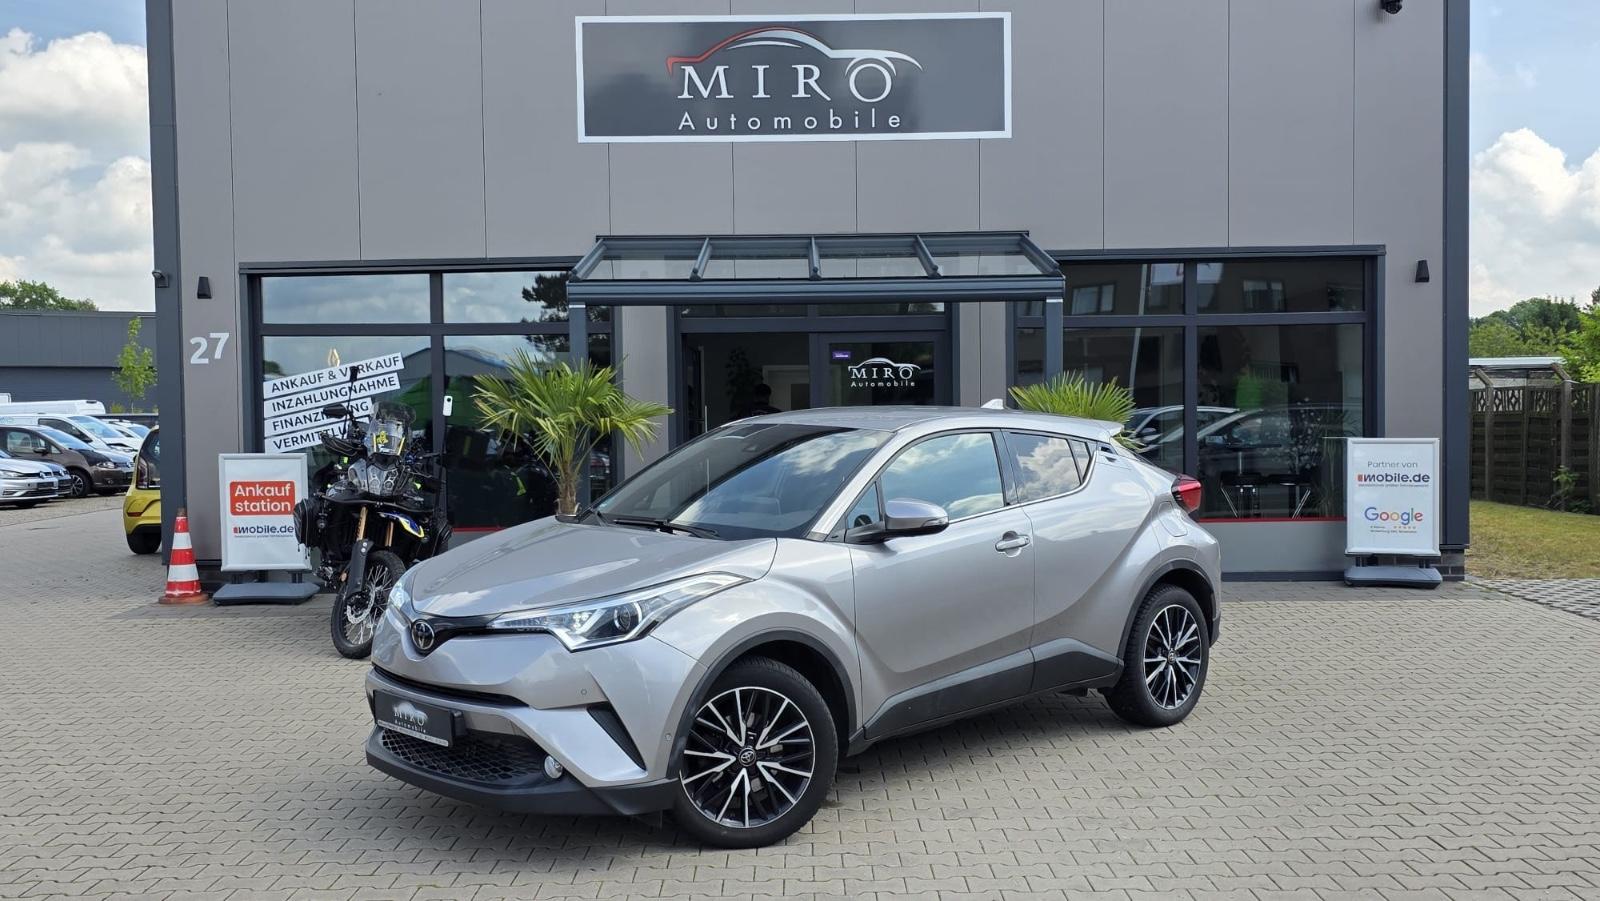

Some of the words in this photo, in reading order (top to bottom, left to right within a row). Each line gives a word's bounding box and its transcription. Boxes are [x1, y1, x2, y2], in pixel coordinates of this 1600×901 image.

[677, 63, 892, 103] MIRO
[678, 108, 901, 131] Automobile
[190, 332, 229, 364] 27
[271, 372, 325, 394] ANKAUF
[328, 370, 337, 380] &
[339, 355, 400, 377] VRKAUF
[850, 367, 913, 380] MIRO
[850, 380, 916, 388] Automobile
[271, 376, 397, 412] INZAHLUNGNAHME
[273, 401, 369, 431] FINANZING
[1367, 461, 1400, 469] Partner
[1401, 461, 1418, 469] von
[1363, 473, 1431, 483] mobile.de
[234, 483, 291, 497] Ankauf
[235, 499, 291, 512] station
[1364, 506, 1423, 526] Google
[238, 525, 294, 534] mobile.de
